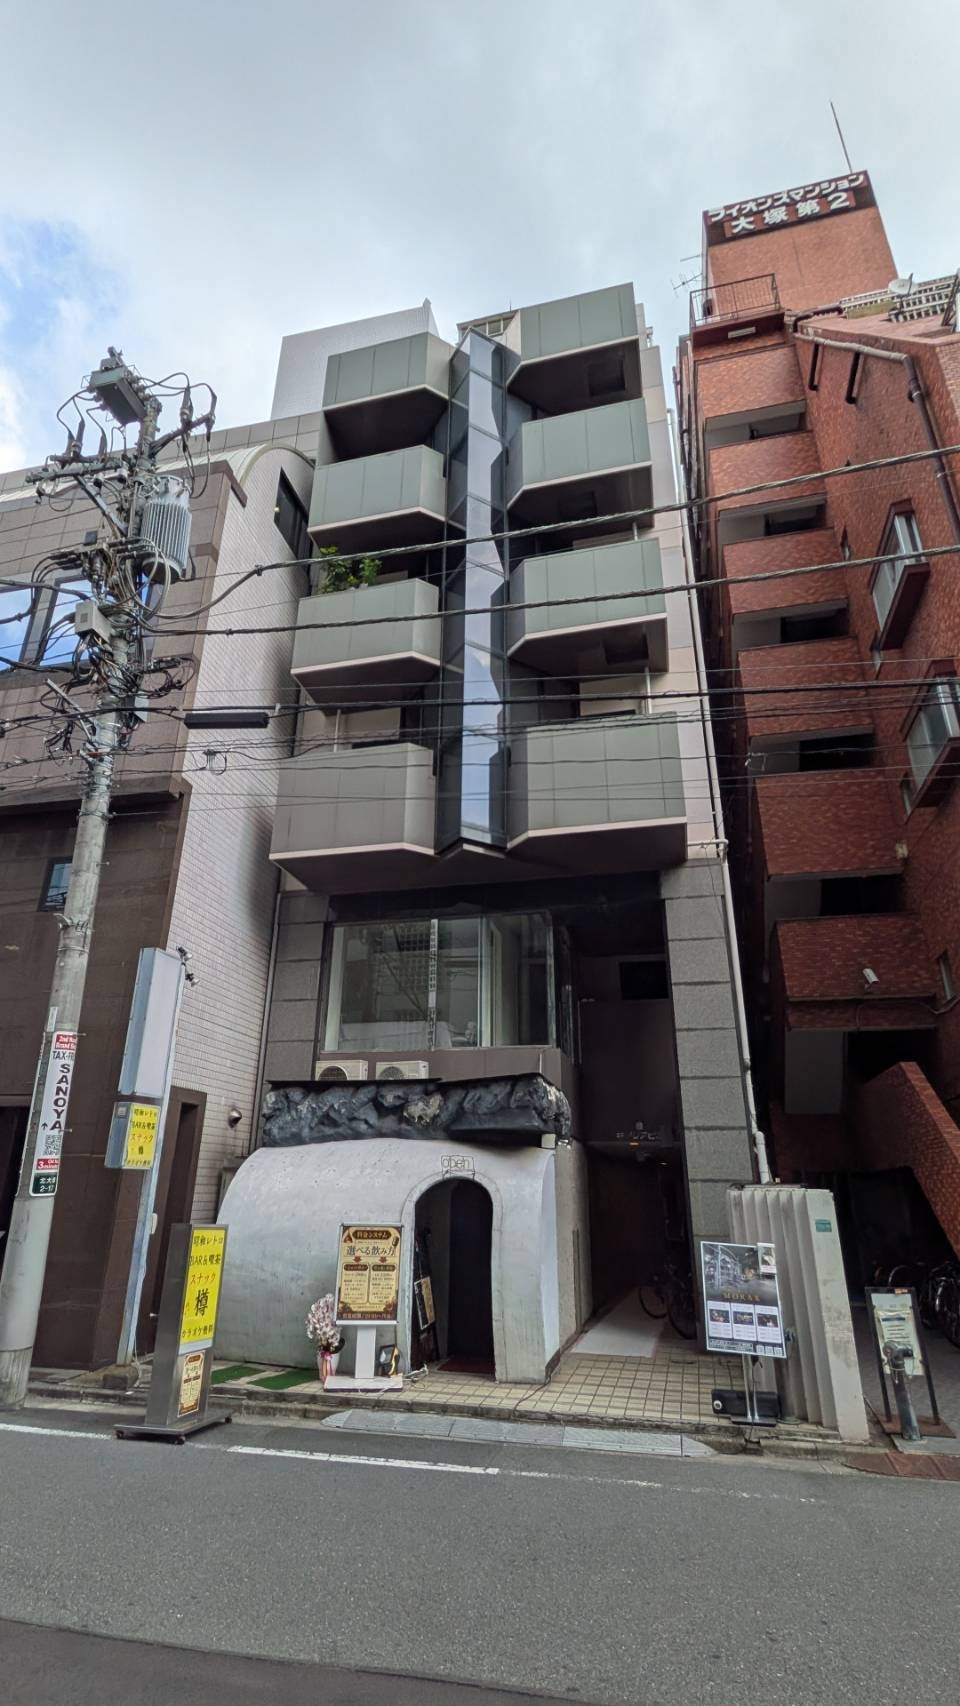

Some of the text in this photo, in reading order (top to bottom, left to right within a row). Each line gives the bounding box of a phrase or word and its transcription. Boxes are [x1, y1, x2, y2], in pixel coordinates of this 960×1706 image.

[708, 173, 864, 222] ライオンズマンション
[731, 191, 850, 234] 大塚第2
[50, 1063, 71, 1131] SANOYA
